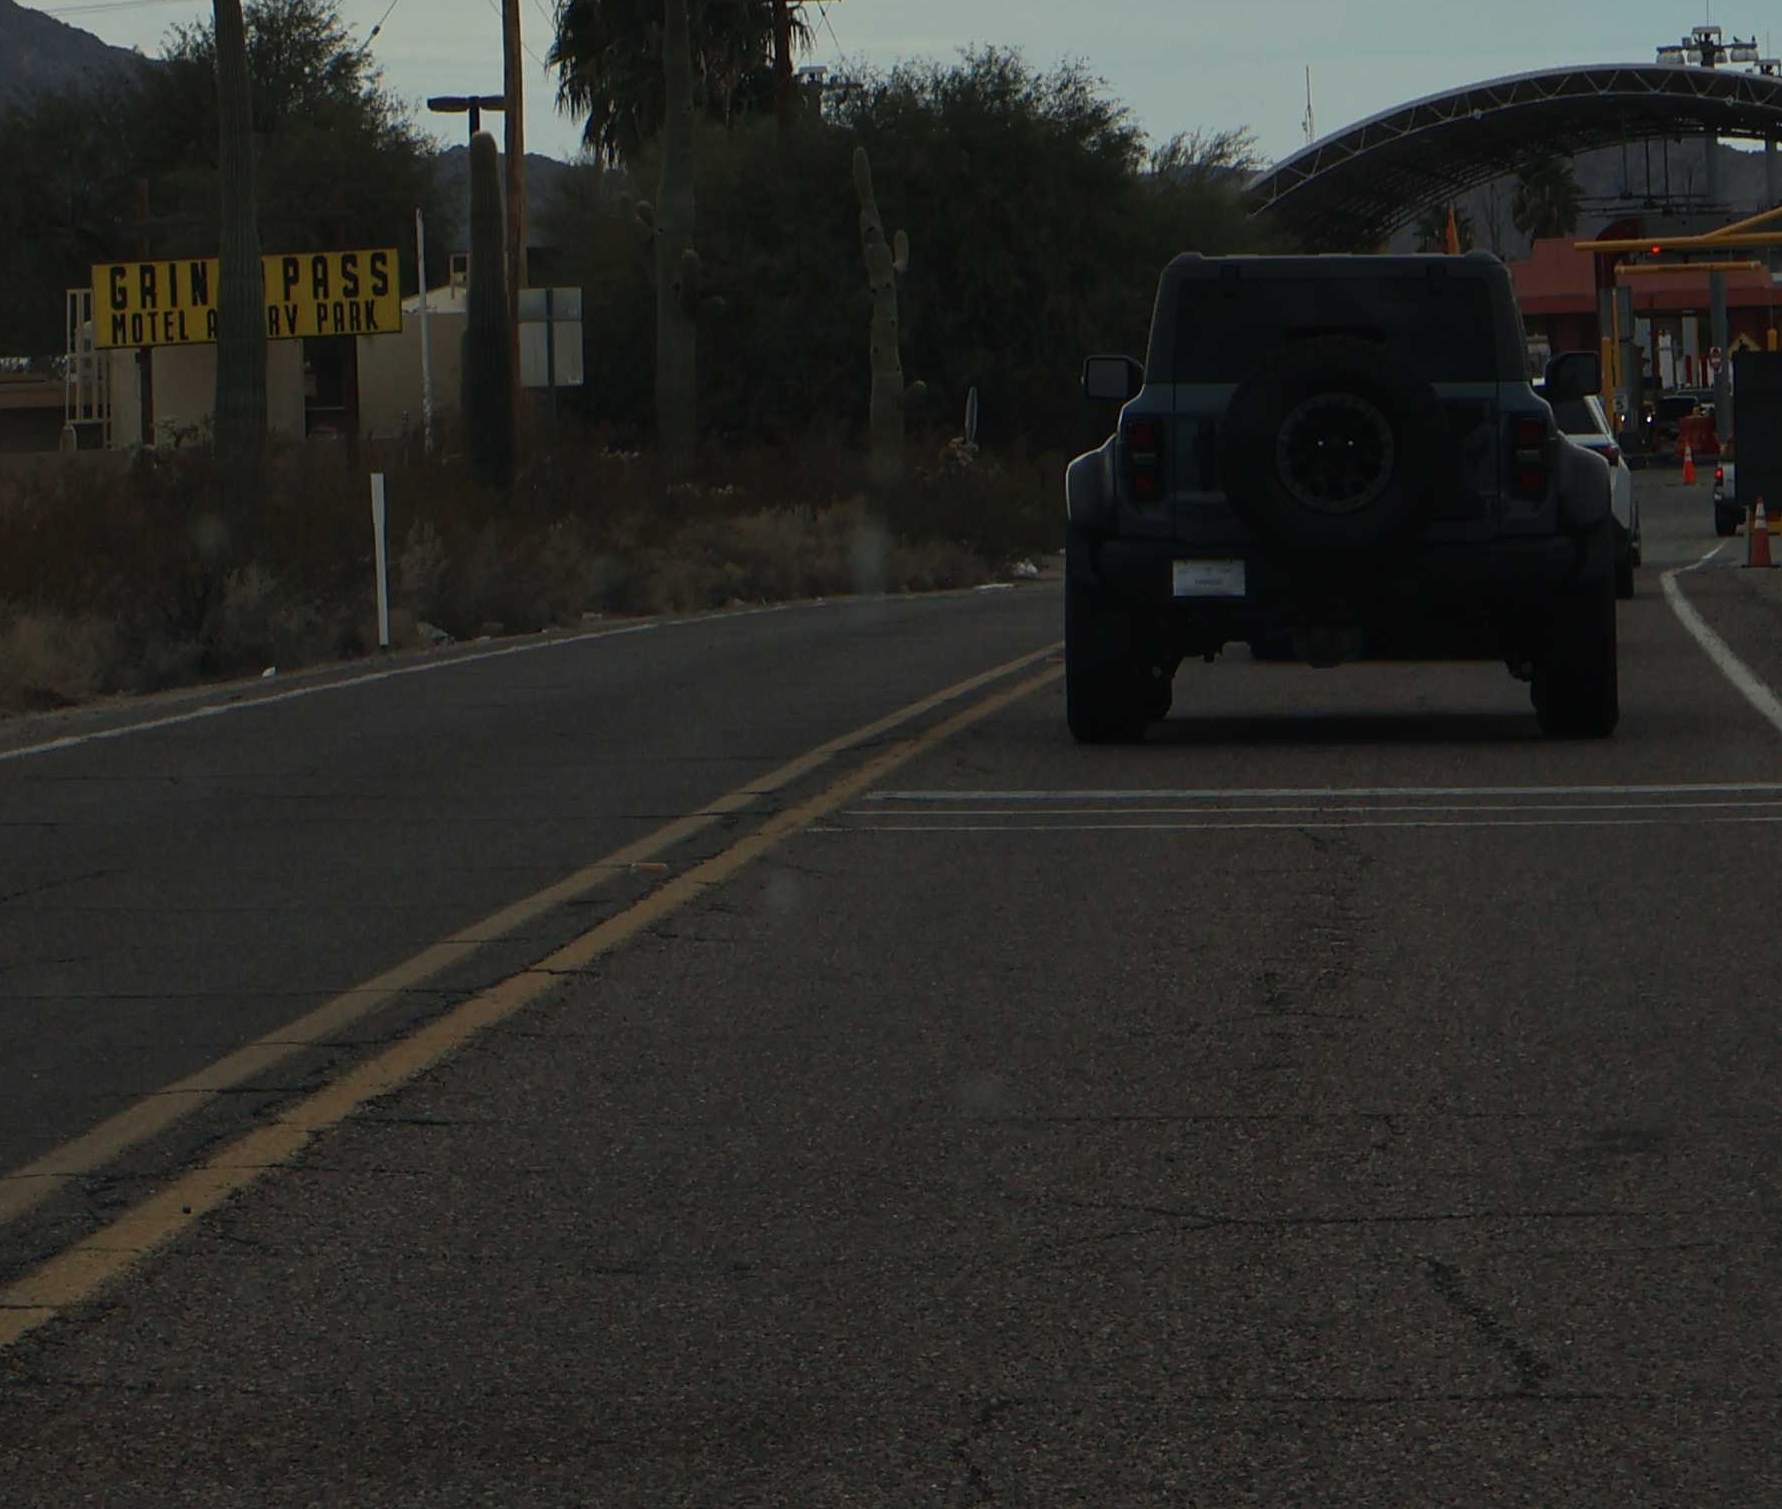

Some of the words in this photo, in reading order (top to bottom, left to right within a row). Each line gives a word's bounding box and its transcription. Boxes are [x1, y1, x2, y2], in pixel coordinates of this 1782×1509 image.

[283, 252, 388, 301] PASS
[111, 311, 189, 344] MOTEL
[269, 305, 298, 335] RV
[317, 299, 378, 333] PARK
